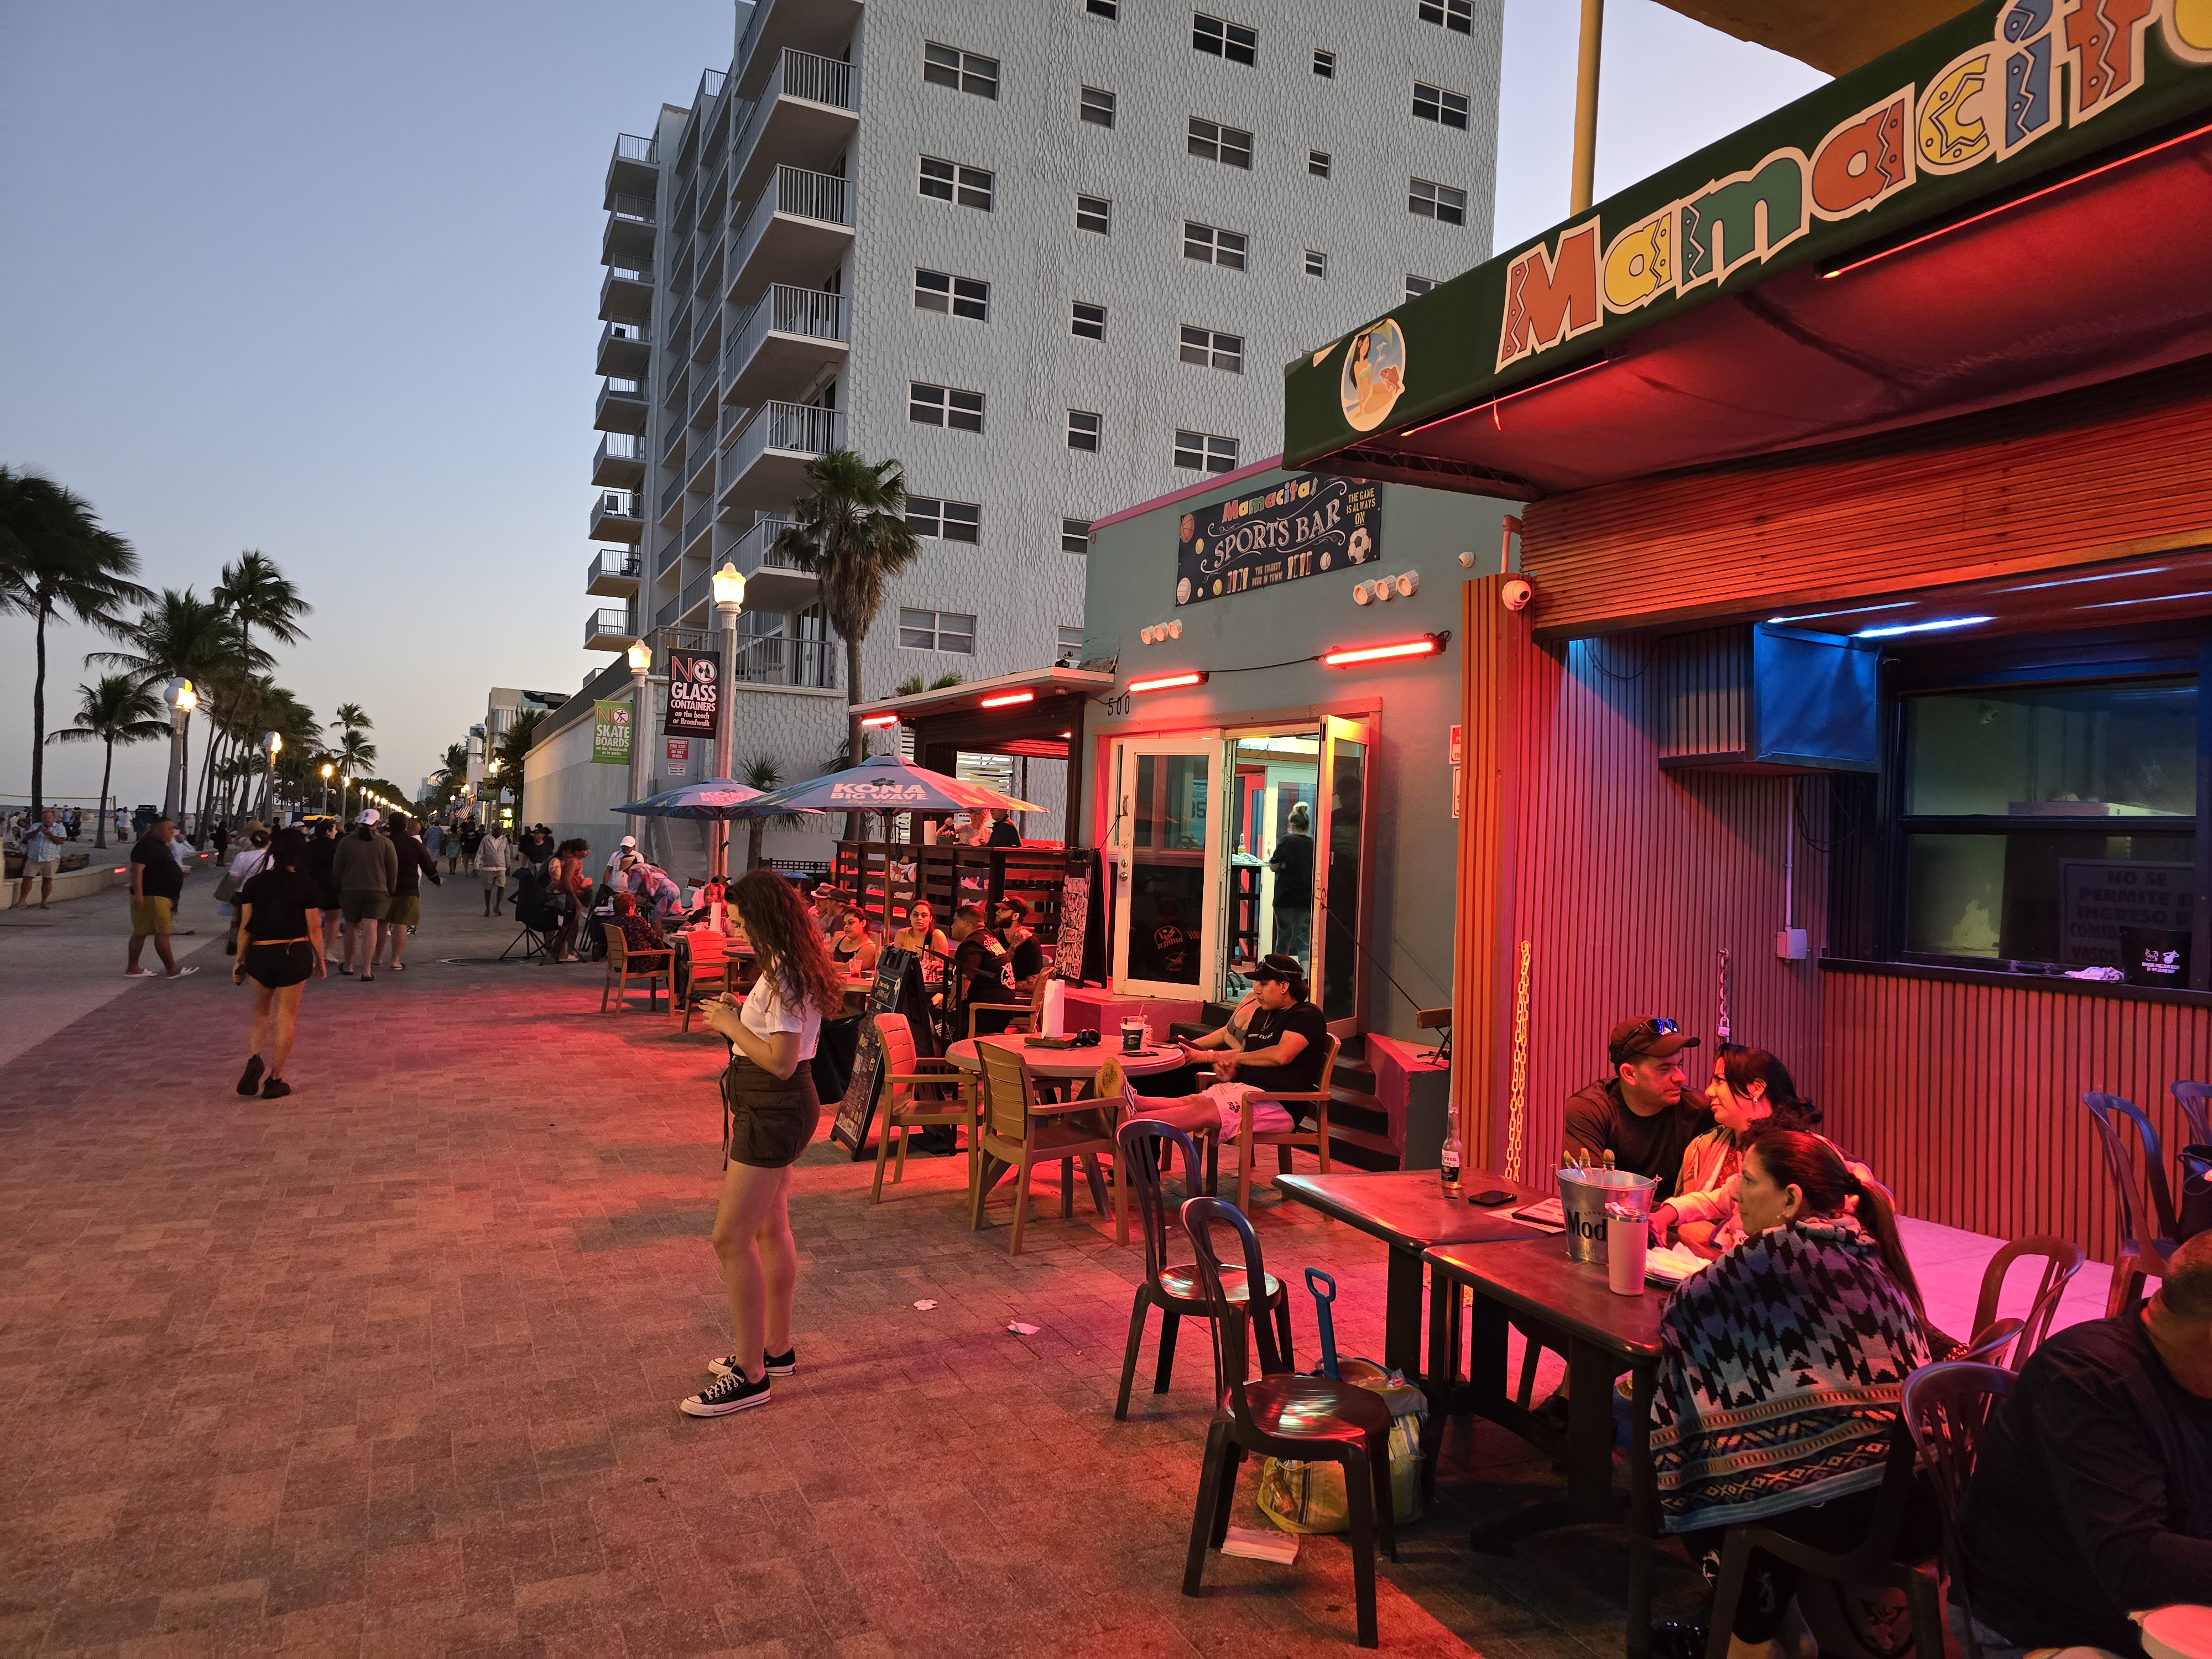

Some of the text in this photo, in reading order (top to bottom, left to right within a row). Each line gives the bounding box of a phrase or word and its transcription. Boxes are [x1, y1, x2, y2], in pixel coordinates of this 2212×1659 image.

[1222, 477, 1318, 523] Mamacitas
[1348, 488, 1374, 503] THE GAME
[1347, 498, 1376, 514] IS ALWAYS
[1355, 511, 1365, 525] ON
[1214, 498, 1341, 568] SPORTS BAR
[671, 656, 717, 684] NO
[671, 682, 716, 702] GLASS
[670, 699, 716, 712] CONTAINERS
[1108, 695, 1130, 716] 500
[596, 706, 630, 726] NO
[680, 718, 709, 727] Broadwalk
[597, 724, 629, 738] SKATE
[596, 737, 629, 748] BOARDS
[833, 783, 926, 794] KONA
[2107, 870, 2168, 887] NO SE
[2079, 886, 2169, 906] PERMITE
[2077, 905, 2168, 925] INGRESO
[2071, 945, 2118, 963] VASOS
[1567, 1208, 1607, 1242] Mod
